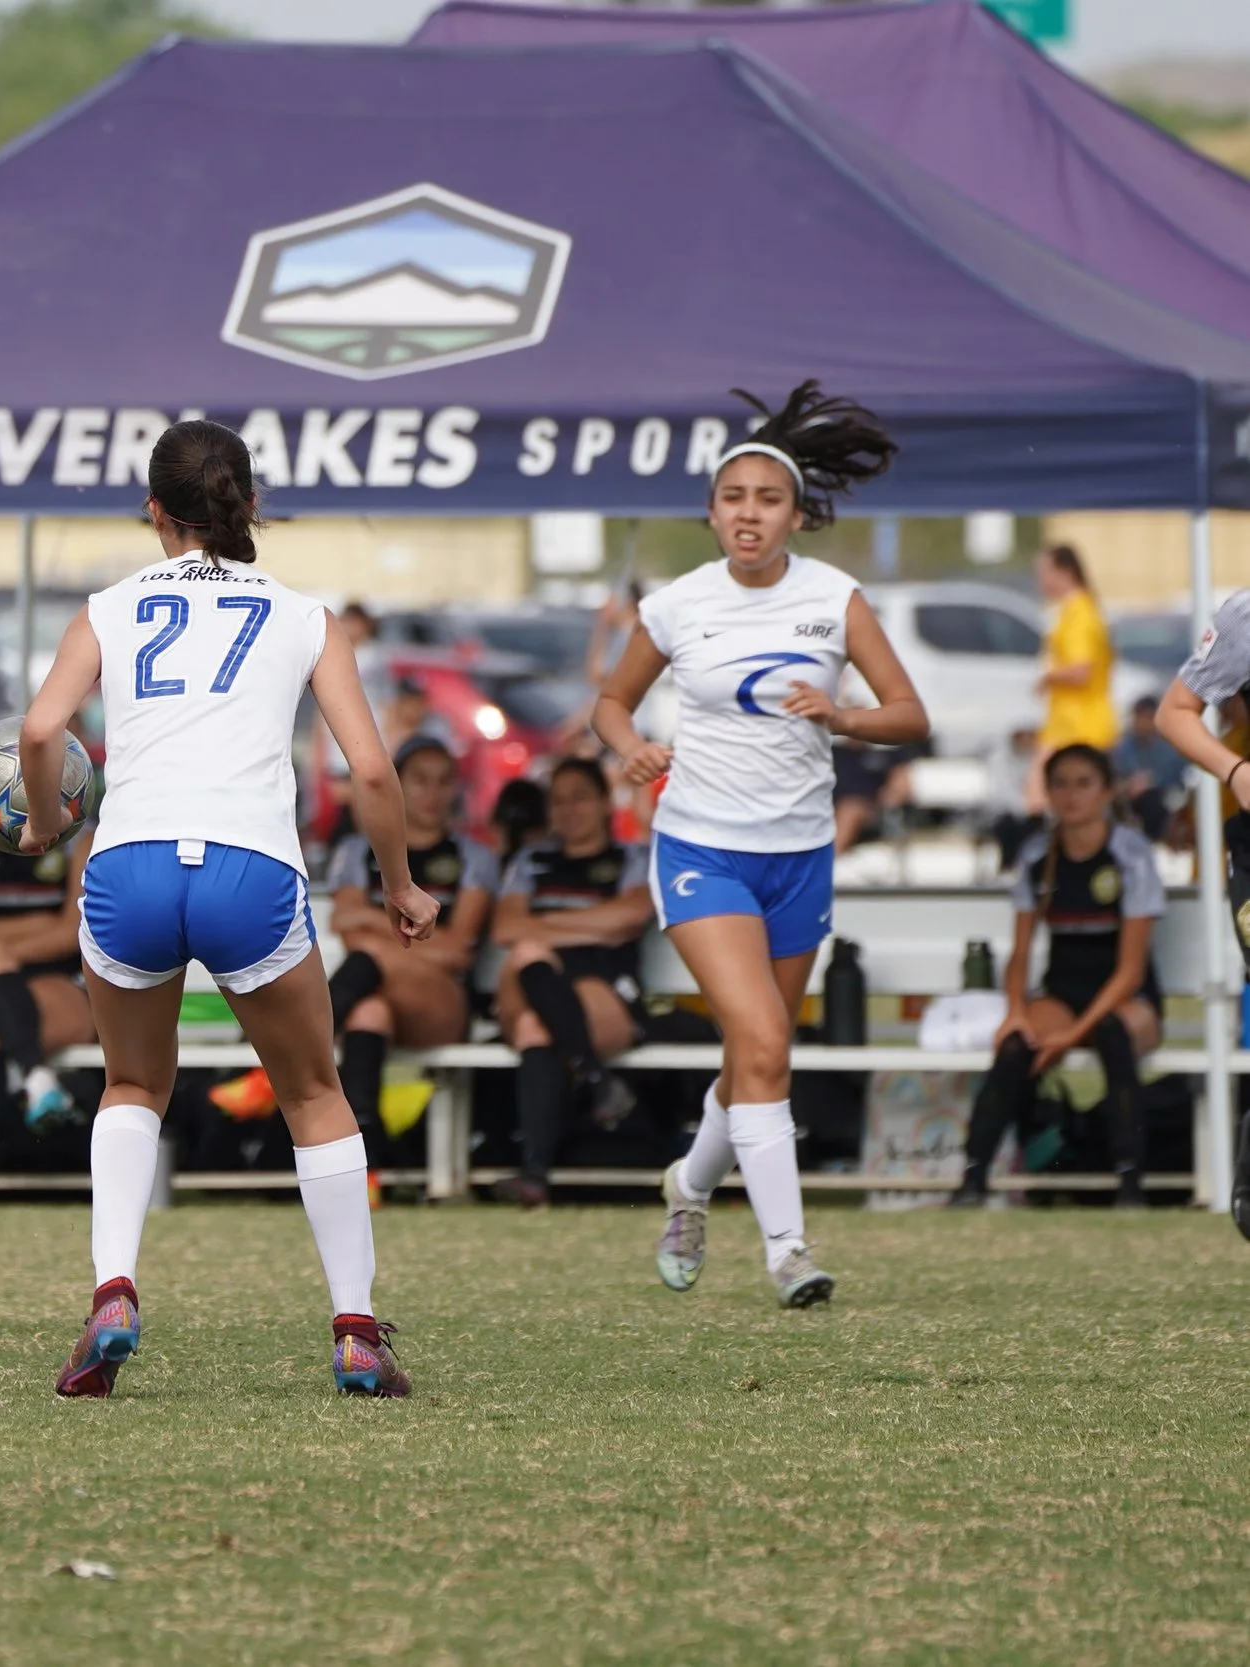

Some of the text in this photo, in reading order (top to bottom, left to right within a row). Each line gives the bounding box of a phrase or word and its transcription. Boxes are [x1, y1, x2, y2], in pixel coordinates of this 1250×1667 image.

[517, 417, 835, 476] SPOR
[139, 571, 268, 586] LOS ANGELES
[134, 593, 273, 701] 27
[793, 623, 836, 639] SURF
